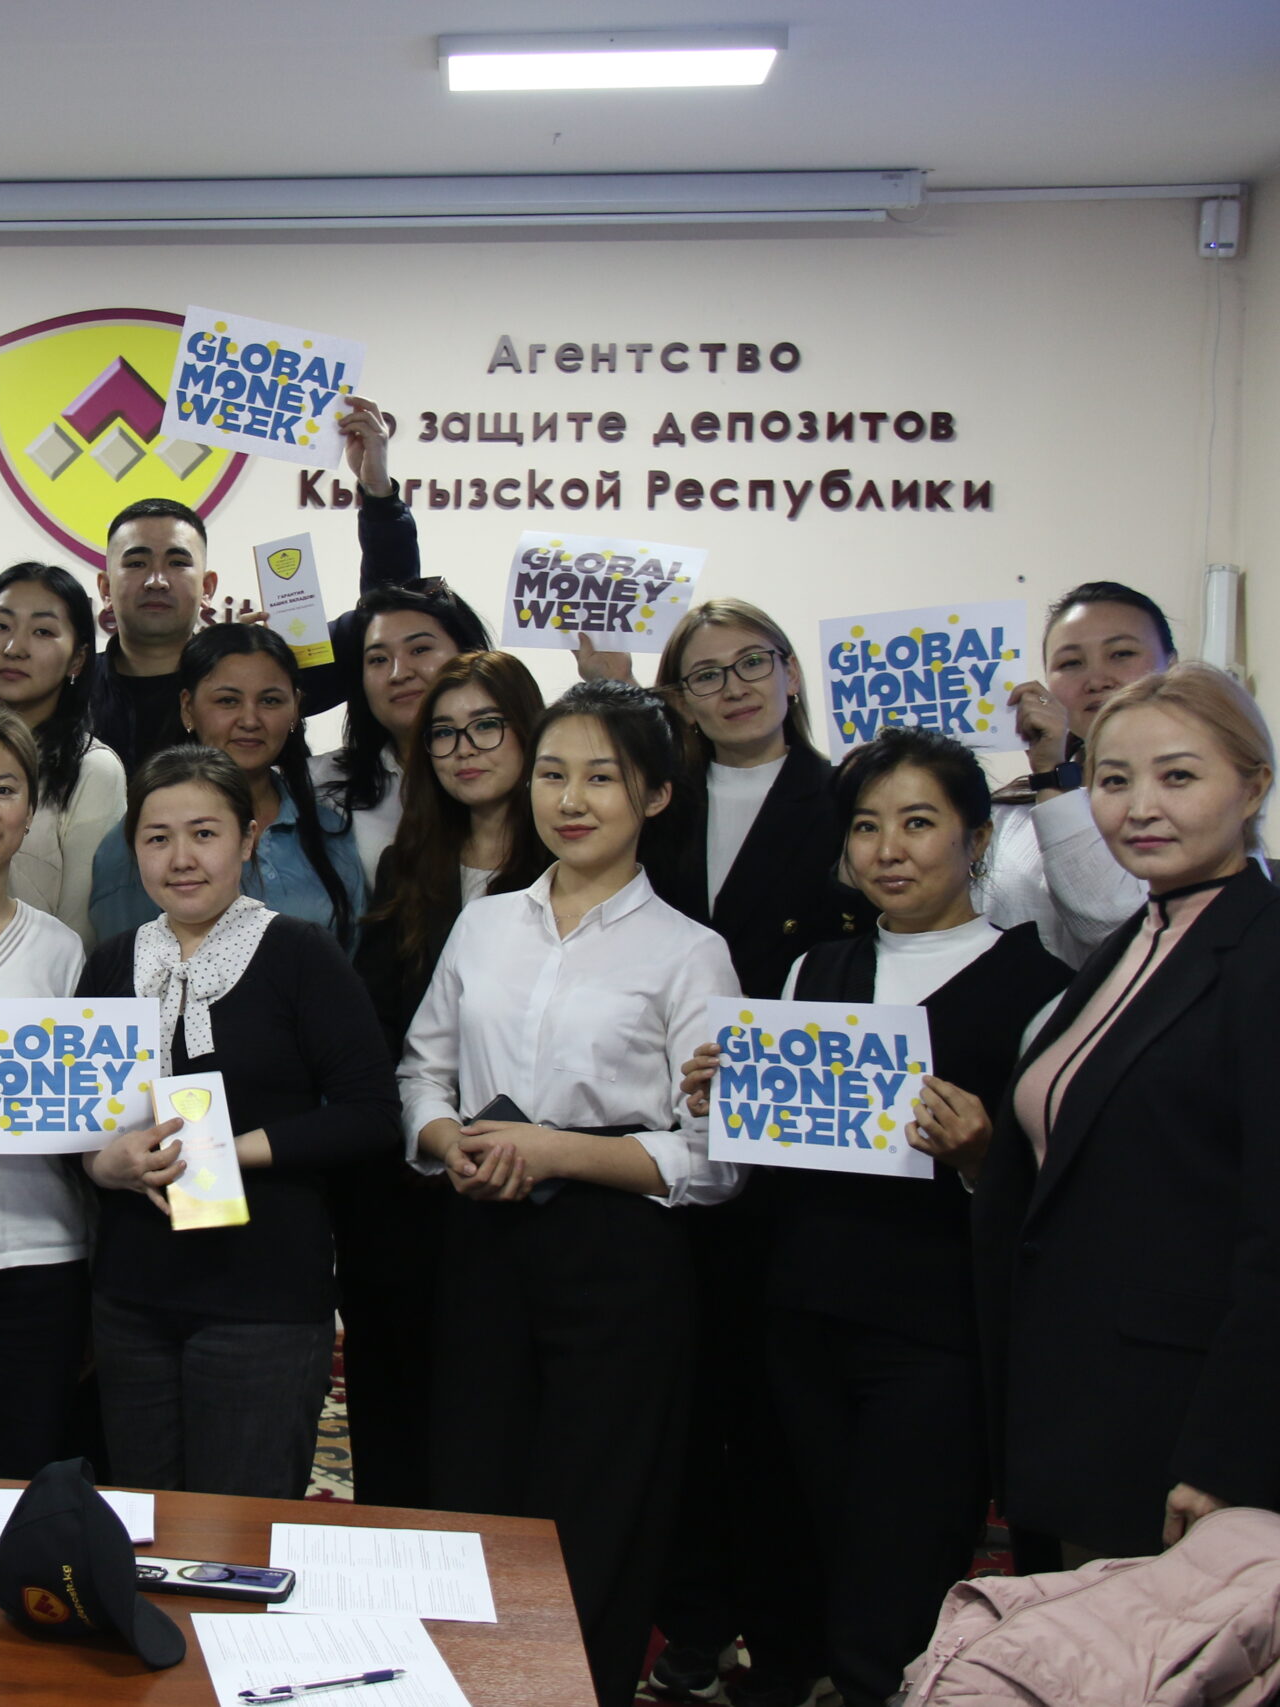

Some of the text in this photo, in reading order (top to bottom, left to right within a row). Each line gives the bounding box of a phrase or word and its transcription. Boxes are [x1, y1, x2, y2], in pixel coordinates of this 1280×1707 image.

[187, 331, 353, 394] GLOBAL
[487, 334, 801, 374] Агентство
[178, 361, 337, 418] MONEY
[176, 389, 303, 445] WEEK
[418, 410, 627, 447] защите
[653, 410, 956, 448] депозитов
[298, 468, 994, 521] Кыгызской Республики
[515, 571, 672, 604] MONEY
[521, 547, 691, 583] GLOBAL
[513, 599, 637, 632] WEEK
[828, 626, 1020, 676] GLOBAL
[831, 661, 1000, 711] MONEY
[832, 699, 975, 744] WEEK
[716, 1025, 927, 1073] GLOBAL
[719, 1064, 907, 1110] MONEY
[718, 1100, 873, 1149] WEEK
